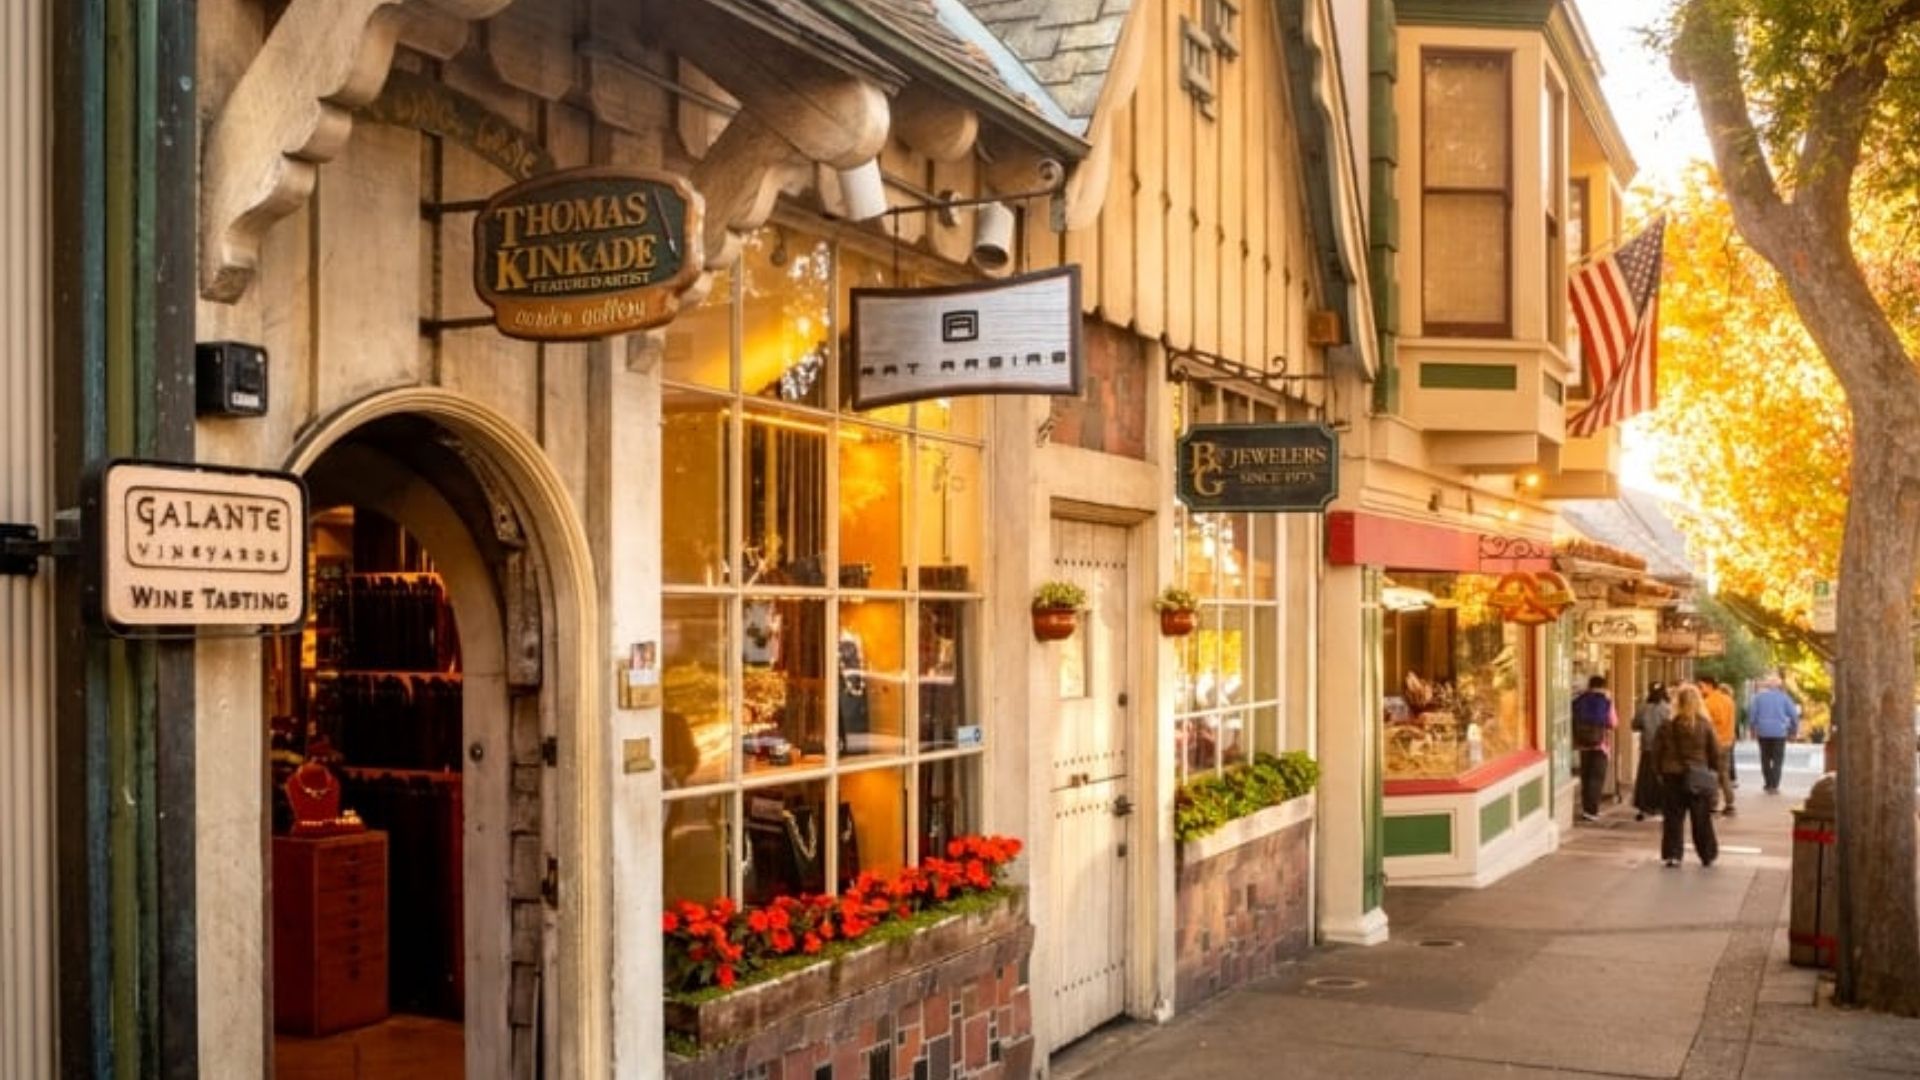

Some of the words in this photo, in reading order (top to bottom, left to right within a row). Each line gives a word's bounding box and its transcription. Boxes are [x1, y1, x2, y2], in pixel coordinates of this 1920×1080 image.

[496, 192, 647, 247] THOMAS
[496, 234, 657, 291] KINKADE
[533, 276, 601, 293] FEATURED
[604, 271, 650, 288] ARTIST
[1229, 446, 1327, 469] JEWELERS
[1240, 471, 1281, 485] SINCE
[136, 496, 281, 536] GALANTE
[137, 543, 279, 563] VINEYARDS
[131, 585, 194, 609] WINE
[202, 587, 289, 610] TASTING
